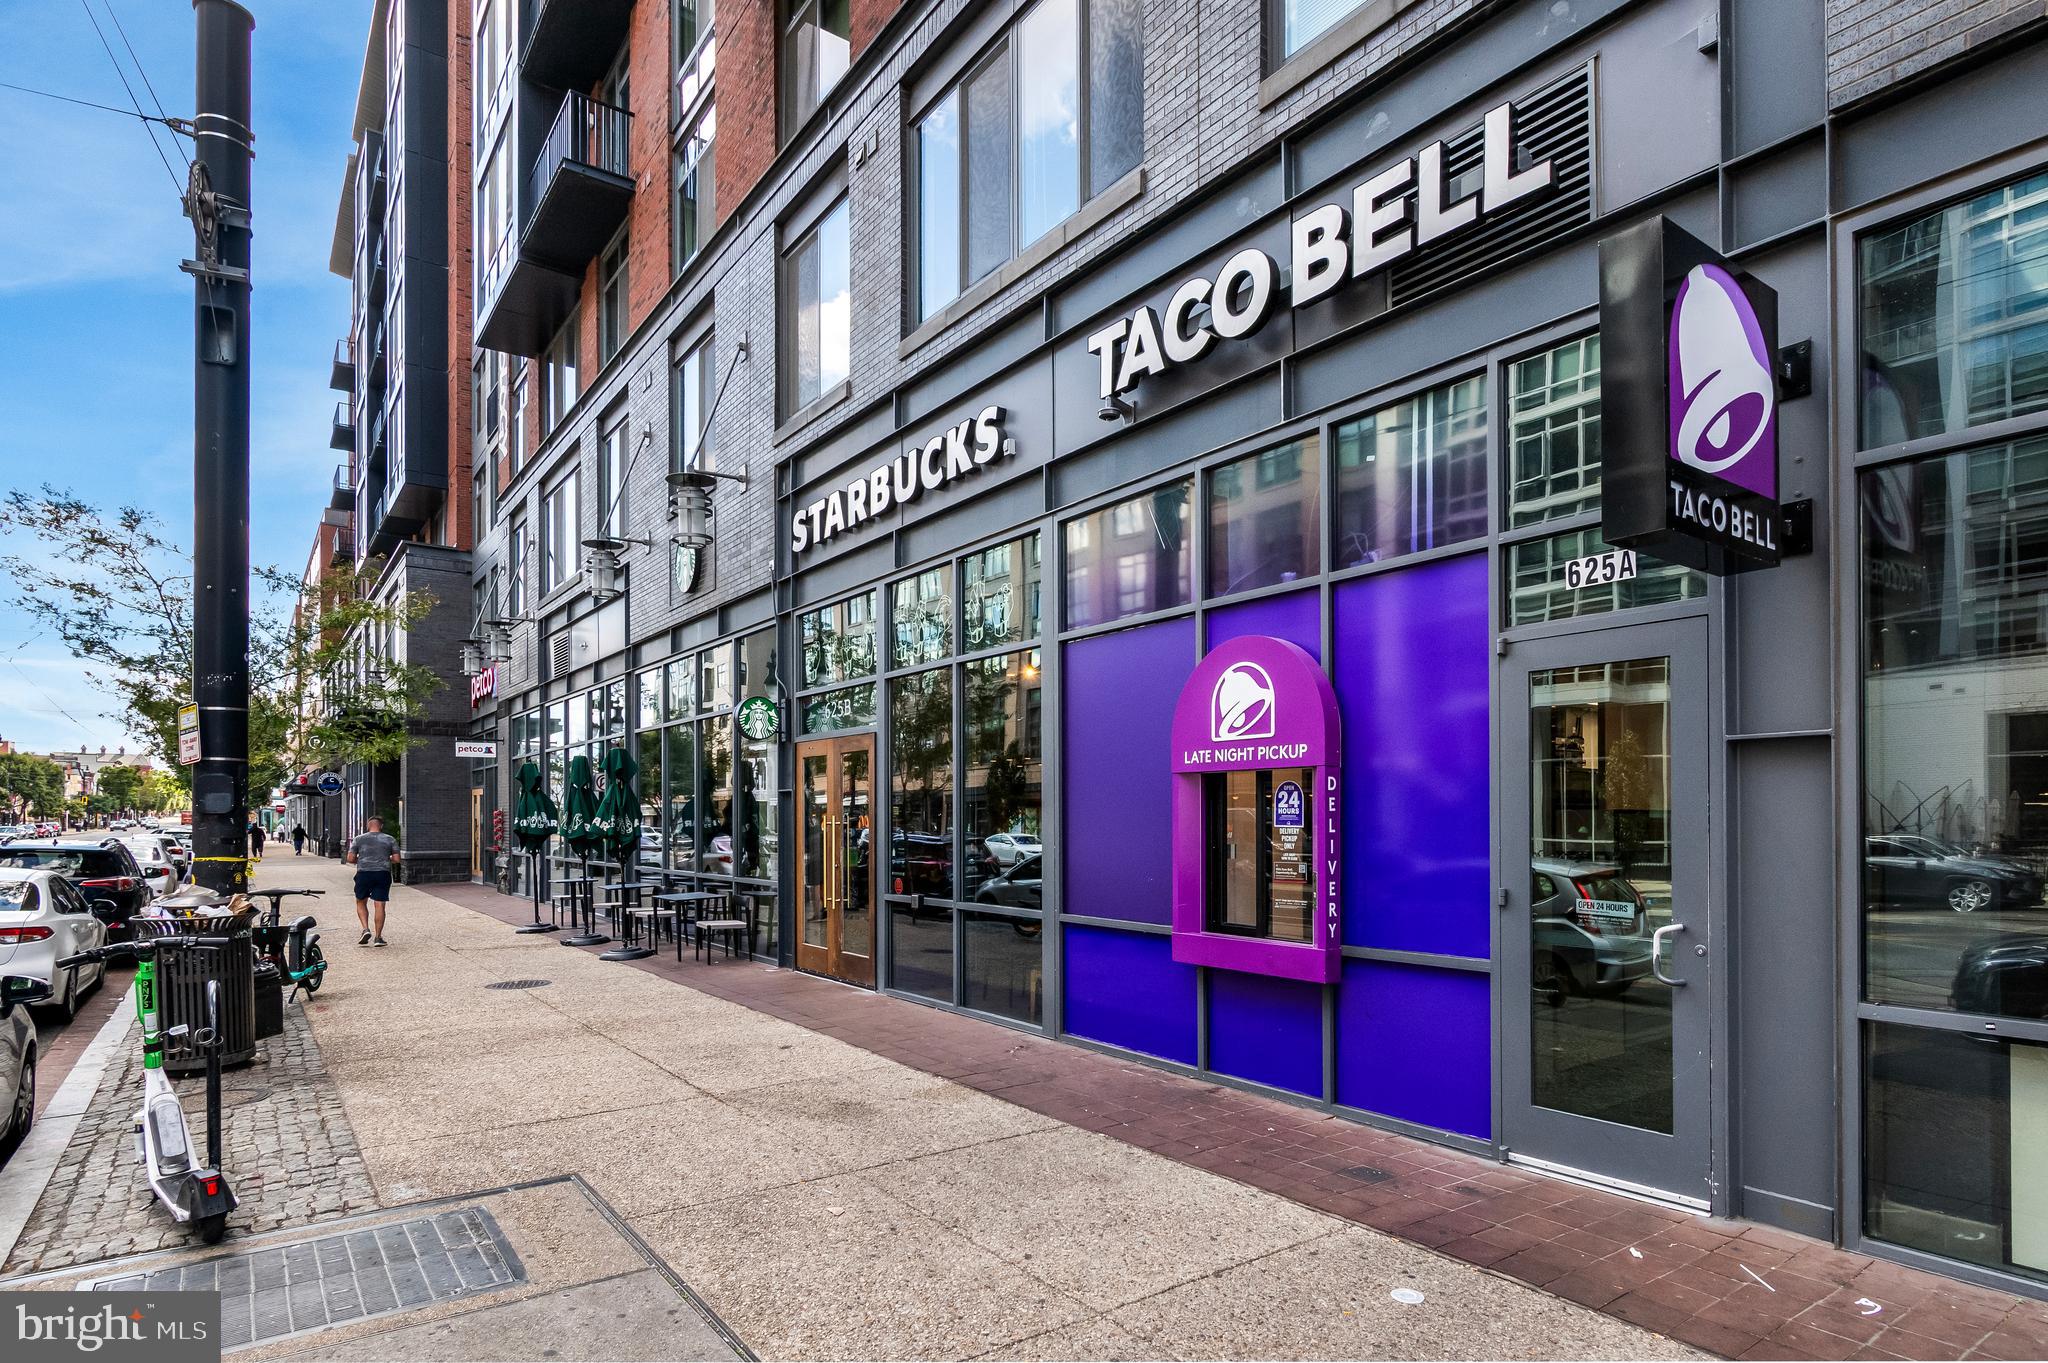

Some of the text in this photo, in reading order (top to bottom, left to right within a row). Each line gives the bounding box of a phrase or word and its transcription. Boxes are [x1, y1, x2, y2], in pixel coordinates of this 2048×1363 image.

[1087, 101, 1556, 399] TACO BELL
[792, 405, 1003, 553] STARBUCKS
[1669, 480, 1776, 550] TACO BELL
[1567, 550, 1635, 588] 625A
[471, 668, 493, 708] petco
[825, 699, 851, 719] 625B
[457, 745, 483, 754] petco
[1184, 743, 1308, 764] LATE NIGHT PICKUP
[1278, 790, 1300, 808] 24
[1278, 807, 1300, 815] HOURS
[1283, 842, 1296, 850] ONLY
[1327, 776, 1338, 938] DELIVERY
[1578, 900, 1595, 910] OPEN
[1596, 902, 1604, 910] 24
[1605, 903, 1629, 913] HOURS
